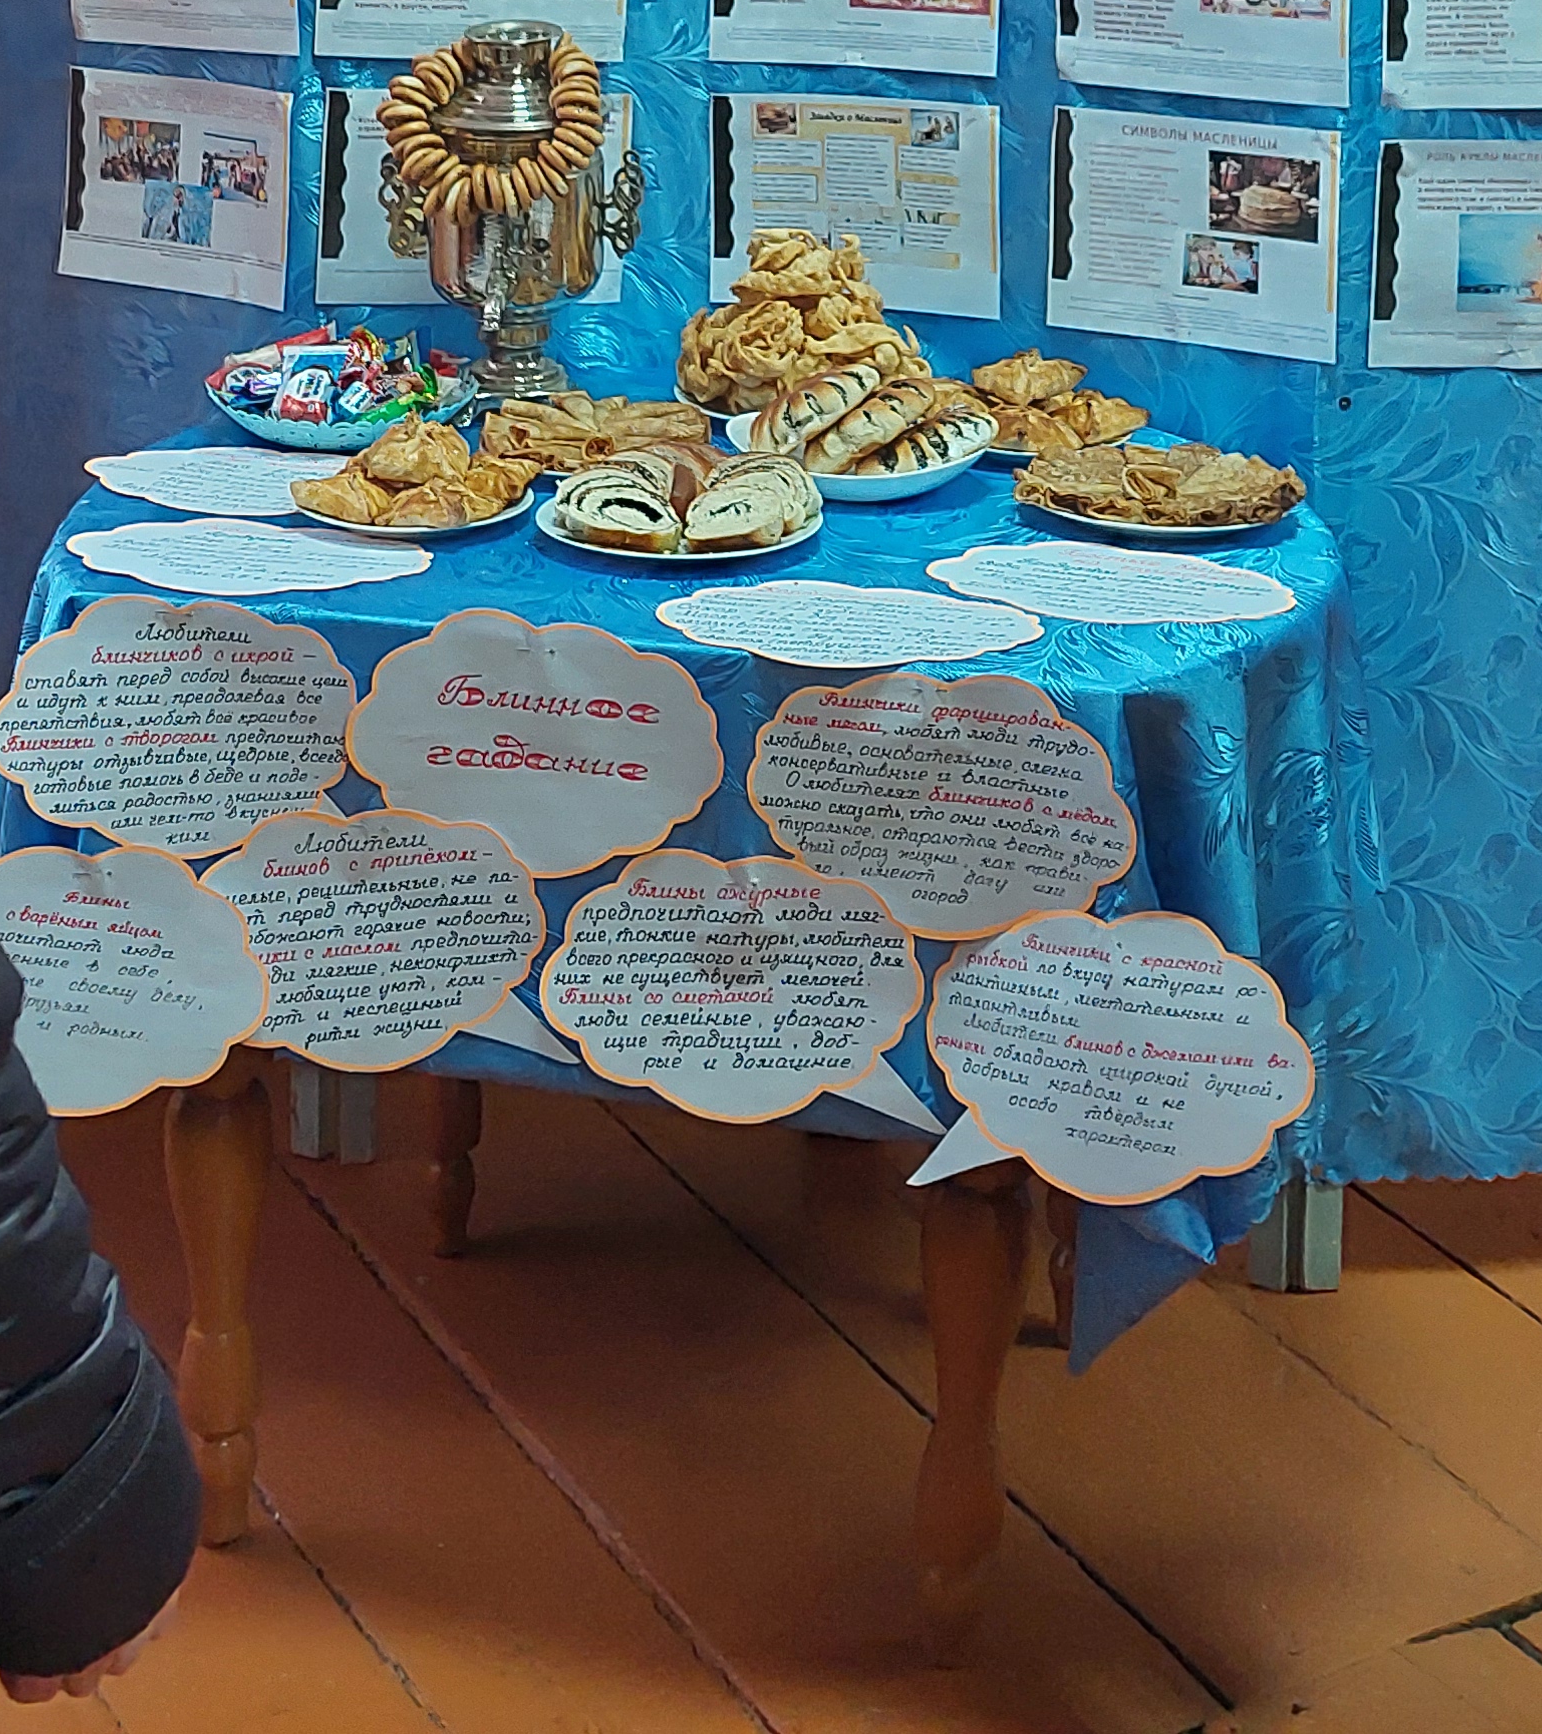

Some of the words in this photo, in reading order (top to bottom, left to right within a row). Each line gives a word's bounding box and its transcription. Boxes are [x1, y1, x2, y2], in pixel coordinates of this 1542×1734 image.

[1121, 124, 1187, 141] СИМВОЛЫ
[1192, 132, 1279, 150] МАСЛЕНИЦЫ
[135, 623, 251, 644] Любители
[92, 646, 202, 665] блинчиков
[231, 648, 293, 664] икрой
[25, 669, 108, 690] ставят
[116, 667, 172, 689] перед
[181, 667, 229, 684] собой
[240, 669, 306, 686] высокие
[36, 692, 88, 715] идут
[172, 687, 285, 708] преодолевая
[296, 690, 322, 705] все
[438, 674, 659, 724] Блинное
[819, 692, 921, 714] Блинчики
[136, 711, 201, 729] любят
[206, 709, 233, 725] всё
[237, 712, 317, 728] красивое
[0, 734, 96, 754] Блинчики
[120, 729, 218, 748] творогом
[967, 727, 1018, 745] люди
[6, 755, 83, 780] натуры
[427, 734, 648, 781] гадание
[33, 775, 112, 796] готовые
[119, 772, 183, 790] помочь
[204, 767, 243, 784] беде
[768, 755, 928, 783] консервативные
[962, 768, 1069, 800] властные
[50, 795, 116, 814] литься
[803, 775, 920, 800] любителях
[928, 786, 1034, 813] блинчиков
[759, 794, 822, 813] можно
[950, 811, 987, 827] они
[294, 832, 427, 855] Любители
[263, 859, 330, 878] блинов
[370, 847, 478, 870] припёком
[841, 842, 888, 869] образ
[451, 873, 476, 885] не
[63, 892, 131, 910] Блины
[627, 878, 707, 900] Блины
[717, 887, 821, 908] ажурные
[912, 882, 969, 906] огород
[277, 902, 336, 926] перед
[345, 894, 493, 918] трудностями
[582, 902, 765, 925] предпочитают
[775, 902, 832, 922] люди
[19, 906, 97, 929] варёным
[107, 921, 164, 939] яйцом
[354, 917, 426, 939] горячие
[615, 927, 696, 943] тонкие
[803, 930, 905, 948] любители
[322, 942, 401, 959] маслом
[565, 947, 611, 966] всего
[616, 952, 734, 967] прекрасного
[869, 951, 904, 968] для
[69, 976, 137, 1004] своему
[553, 971, 592, 985] них
[602, 972, 624, 985] не
[631, 967, 764, 990] существует
[275, 983, 371, 1005] любящие
[343, 990, 462, 1019] неспешный
[558, 987, 632, 1005] Блины
[644, 992, 663, 1004] со
[672, 990, 773, 1005] сметаной
[791, 990, 868, 1009] любят
[574, 1008, 628, 1028] люди
[304, 1026, 360, 1048] ритм
[604, 1035, 647, 1053] щие
[642, 1055, 682, 1074] рые
[733, 1053, 851, 1072] домашние
[1008, 1094, 1058, 1114] особо
